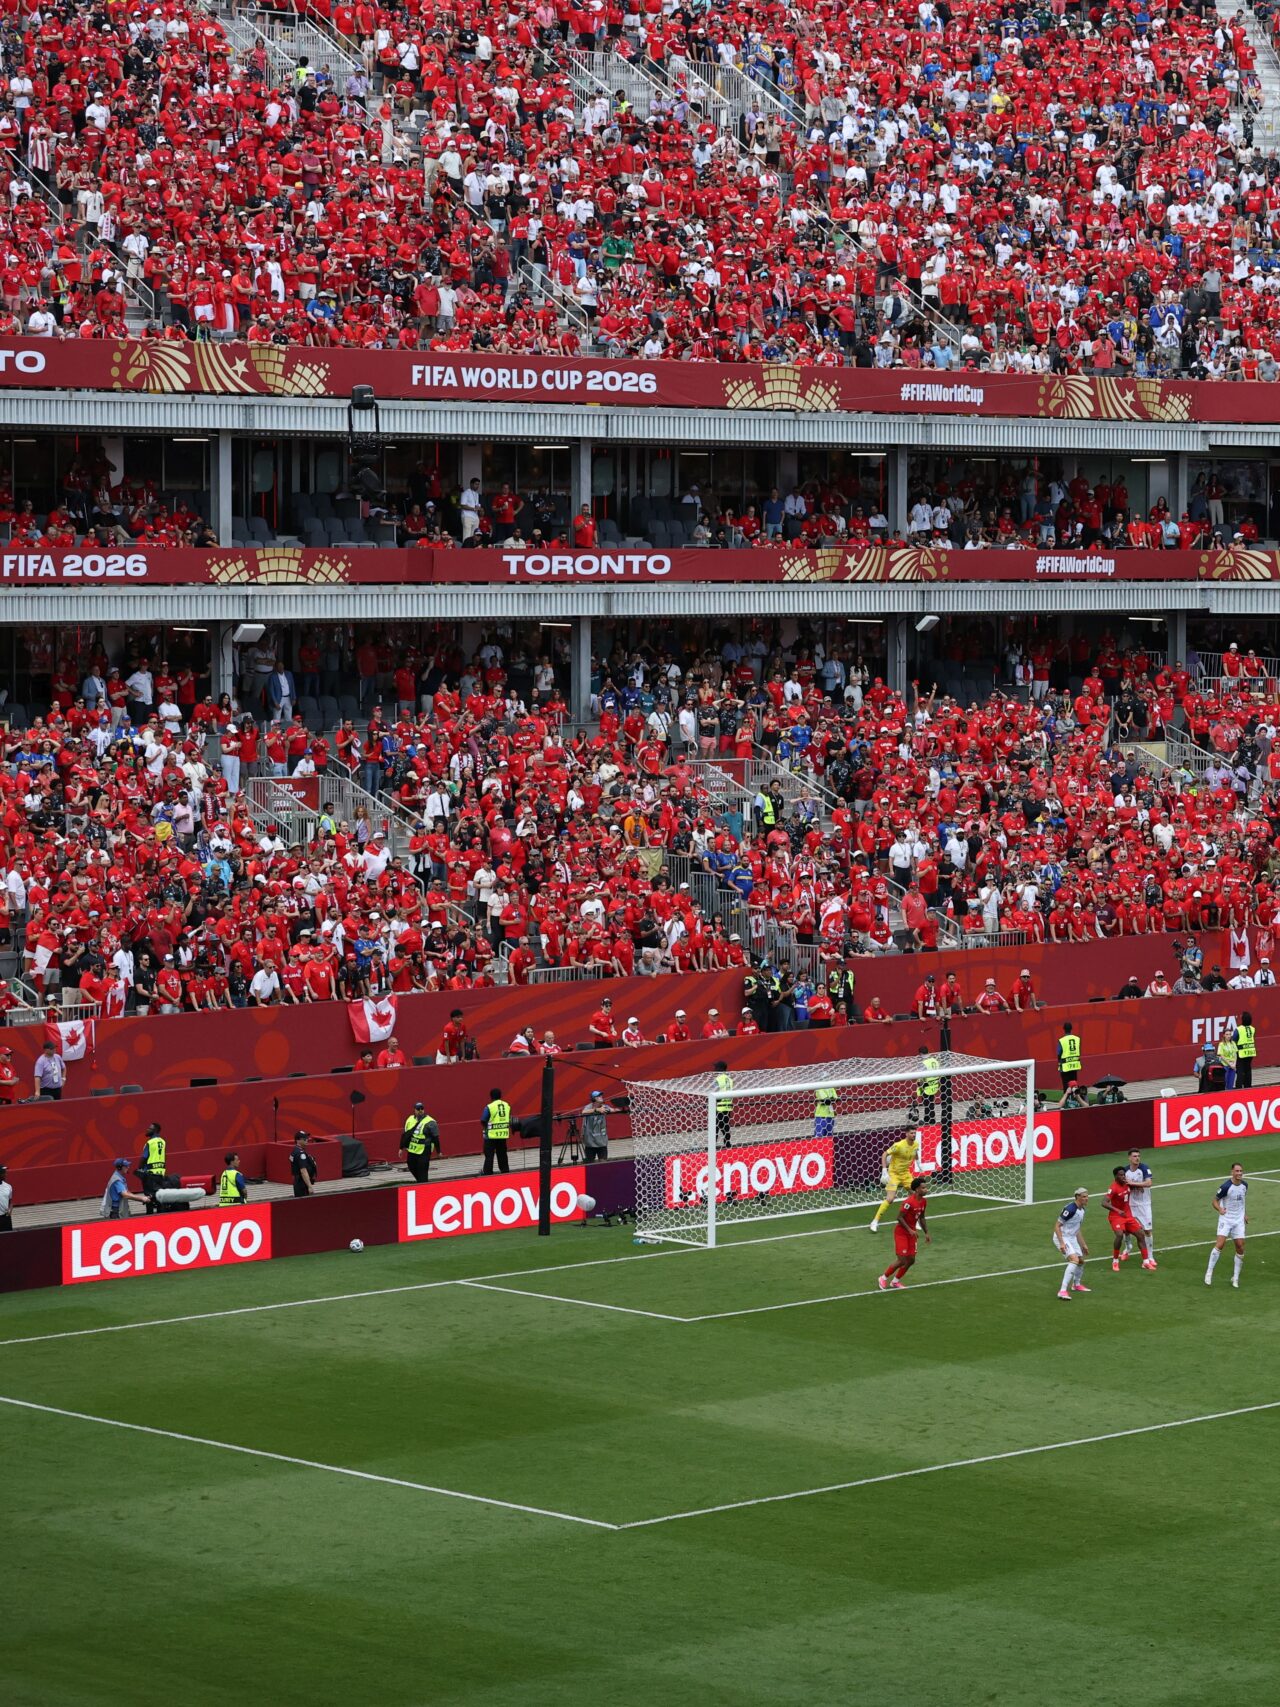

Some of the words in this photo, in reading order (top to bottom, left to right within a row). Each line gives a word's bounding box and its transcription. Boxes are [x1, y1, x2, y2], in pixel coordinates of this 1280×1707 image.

[412, 365, 457, 387] FIFA
[460, 367, 537, 389] WORLD
[541, 370, 582, 391] CUP
[586, 371, 657, 393] 2026
[900, 384, 984, 406] #FIFAWorldCup
[3, 555, 57, 576] FIFA
[62, 554, 148, 576] 2026
[502, 555, 672, 576] TORONTO
[1035, 556, 1115, 576] #FIFAWorldCup
[1192, 1016, 1238, 1043] FIFA
[915, 1125, 1054, 1172] Lenovo
[673, 1152, 826, 1202] Lenovo
[407, 1182, 578, 1236] Lenovo
[71, 1219, 262, 1278] Lenovo
